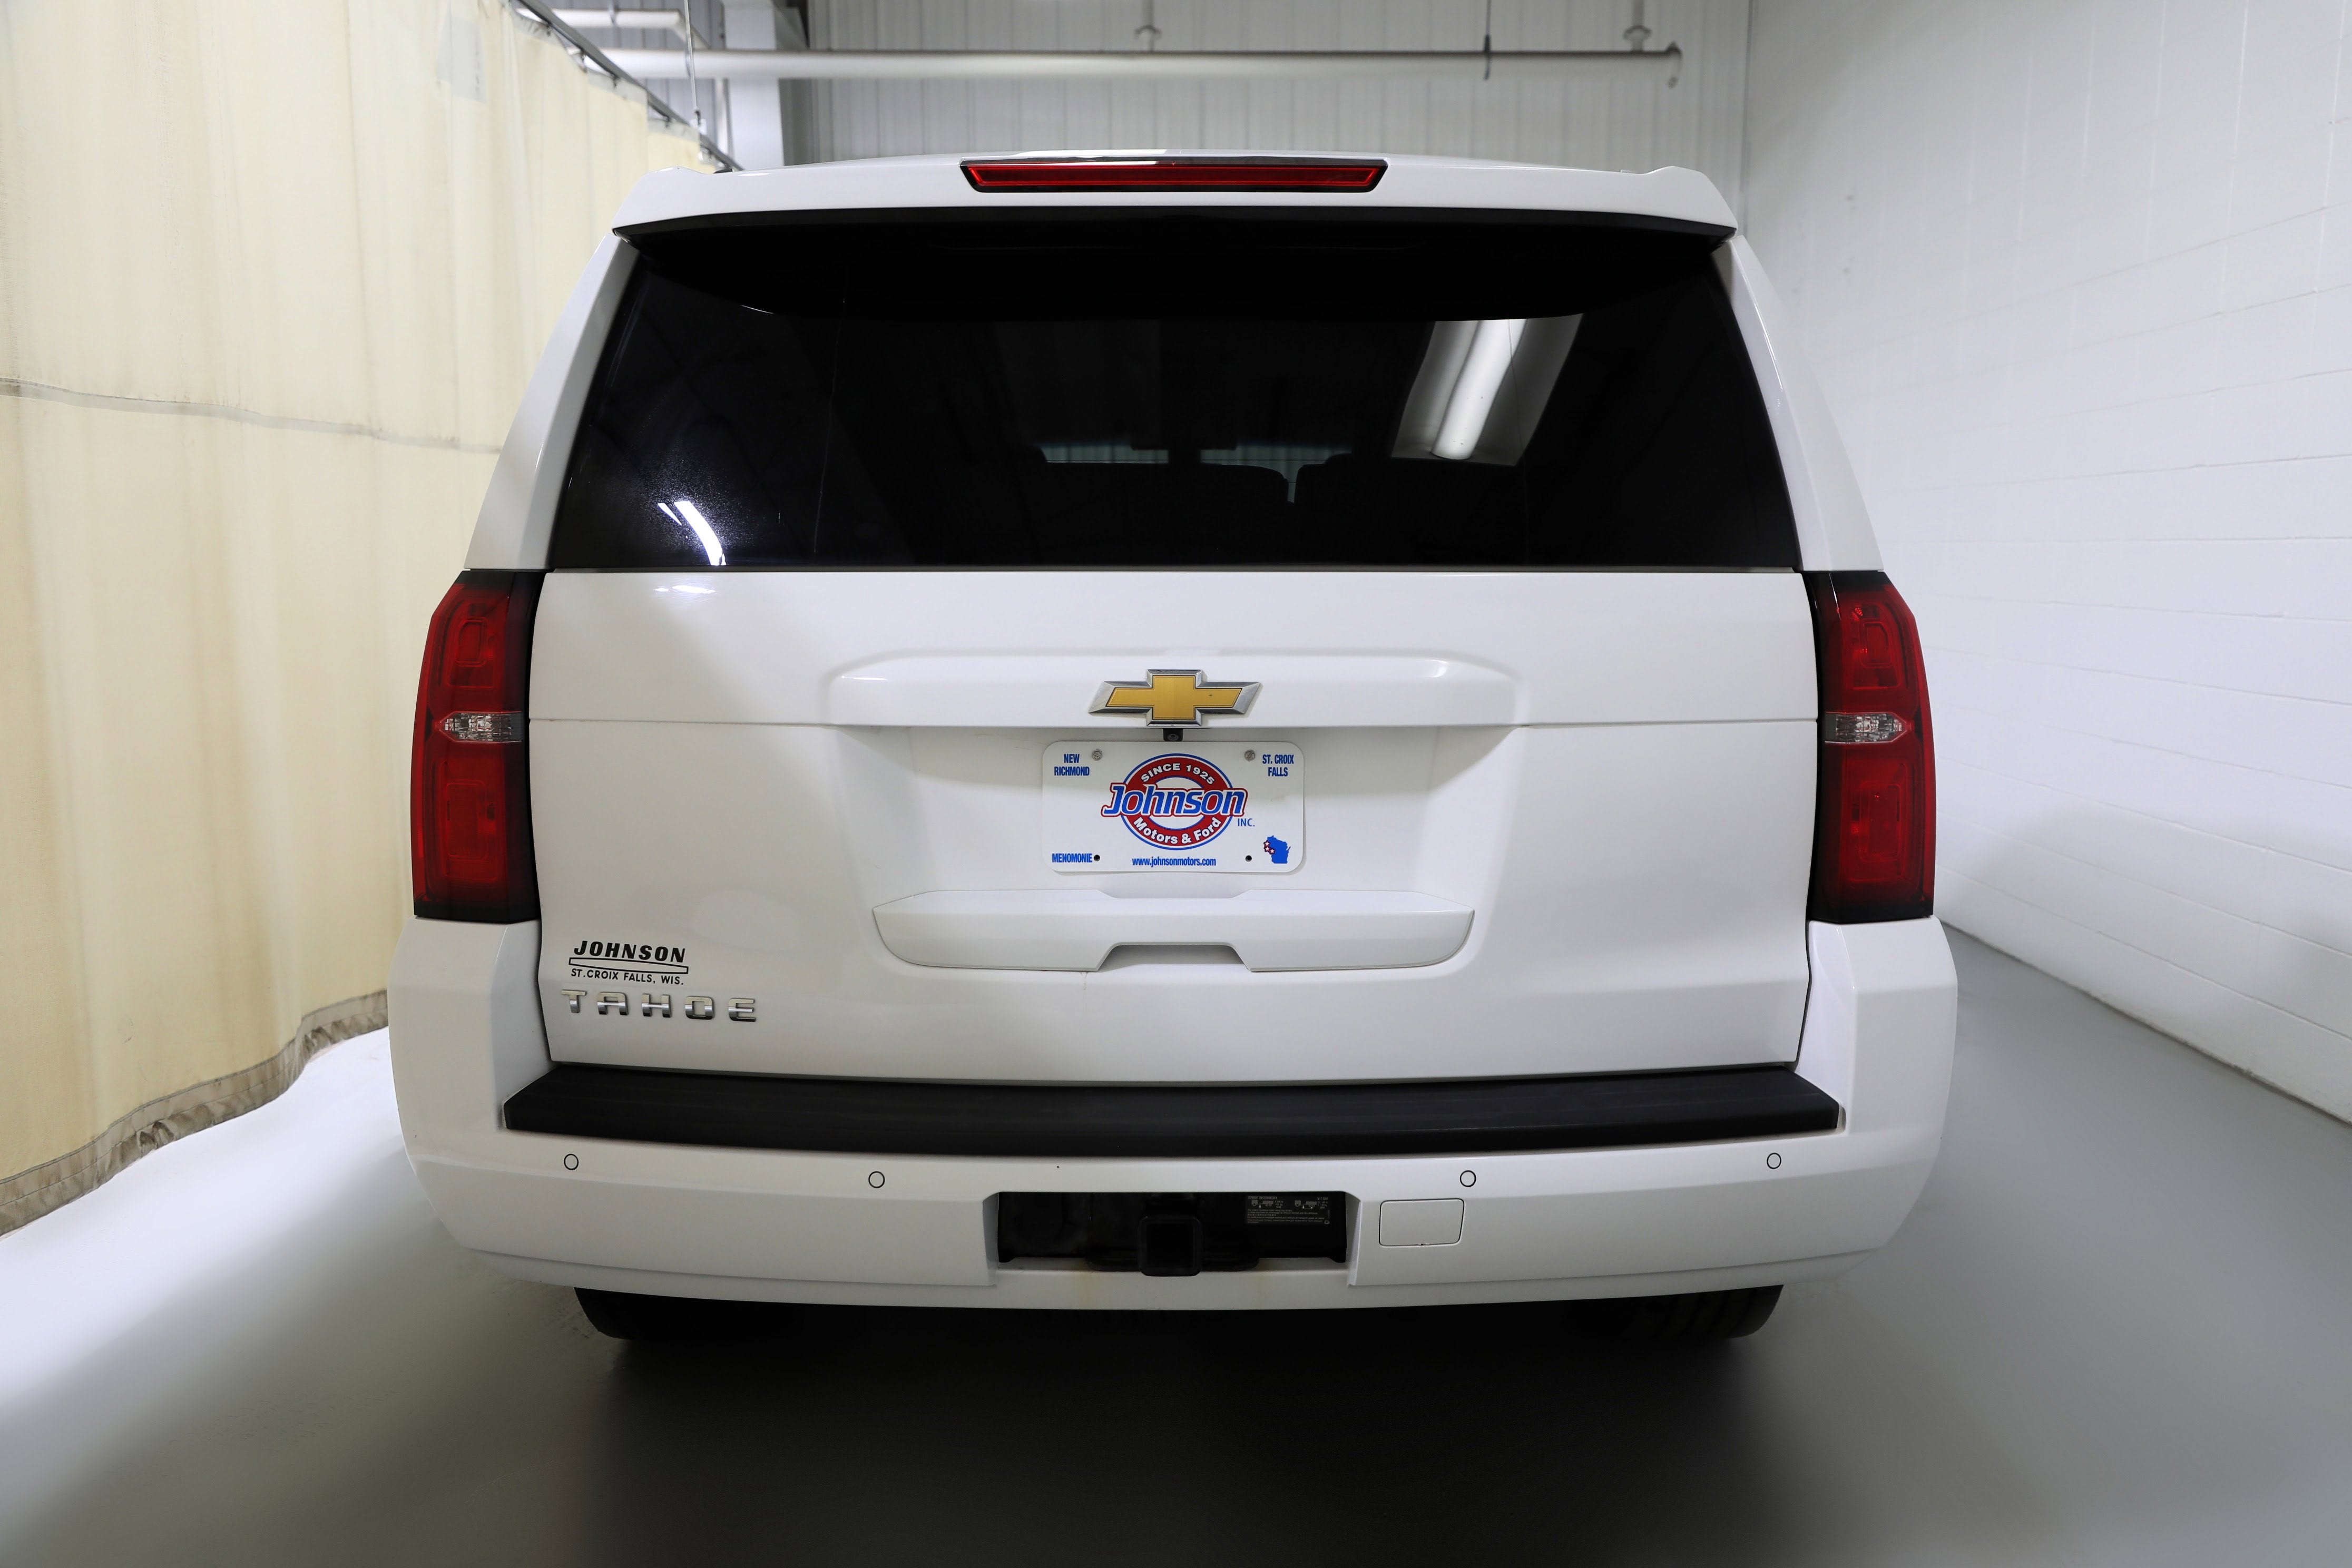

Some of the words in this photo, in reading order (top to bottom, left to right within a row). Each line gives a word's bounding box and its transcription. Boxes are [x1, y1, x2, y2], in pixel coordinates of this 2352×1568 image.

[1064, 753, 1080, 763] NEW
[1262, 754, 1273, 765] ST.
[1274, 754, 1295, 765] CROIX
[1054, 766, 1090, 776] RICHMOND
[1141, 763, 1181, 782] SINCE
[1186, 765, 1215, 785] 1925
[1268, 767, 1288, 777] FALLS
[1103, 784, 1245, 815] Johnson
[1237, 818, 1256, 827] INC.
[1133, 817, 1178, 844] Motors
[1181, 833, 1192, 844] &
[1193, 817, 1221, 841] Ford
[1052, 854, 1093, 863] MENOMONIE
[1132, 857, 1216, 867] www.johnsonmotors.com
[574, 940, 685, 963] JOHNSON
[661, 975, 684, 985] WIS.
[561, 989, 757, 1022] TAHOE
